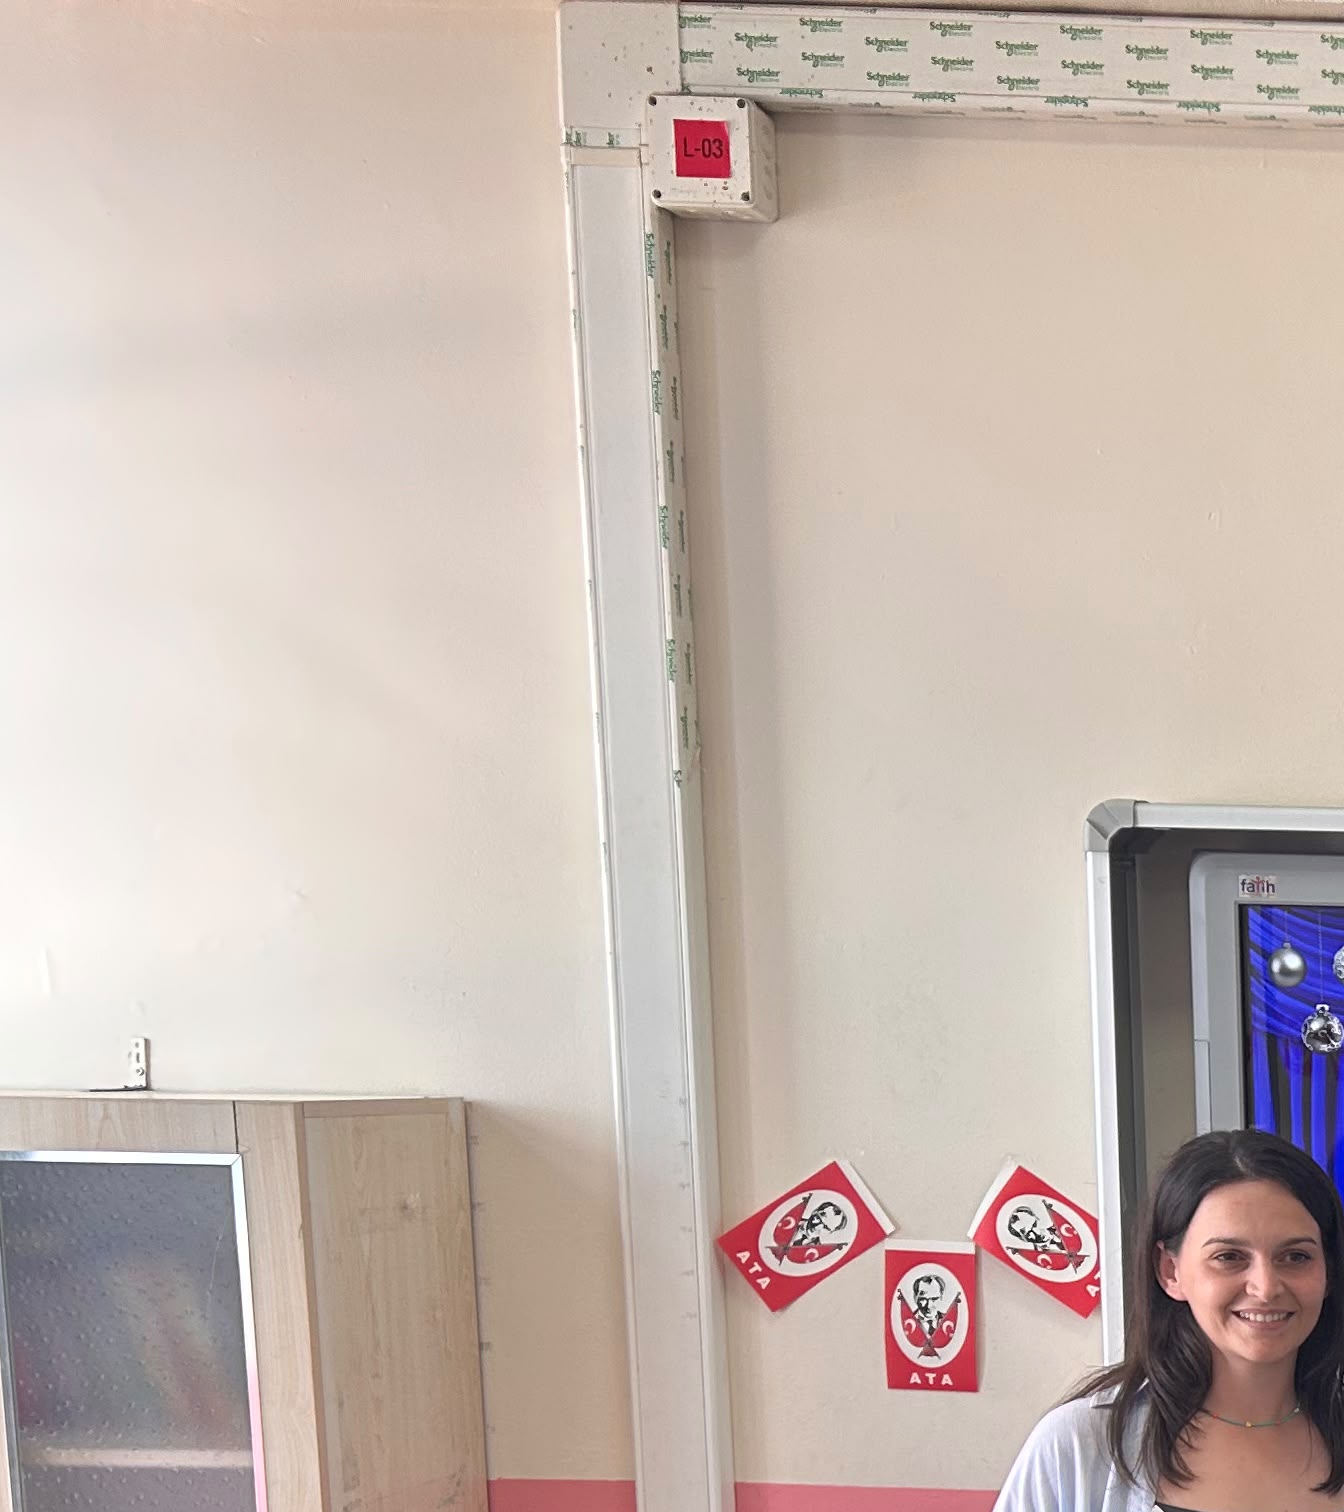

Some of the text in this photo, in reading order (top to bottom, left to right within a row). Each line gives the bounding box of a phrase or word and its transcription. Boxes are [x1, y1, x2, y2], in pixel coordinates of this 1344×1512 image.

[683, 136, 723, 159] L-03
[1241, 875, 1276, 893] fatih
[736, 1250, 771, 1290] ATA
[909, 1372, 953, 1386] ATA
